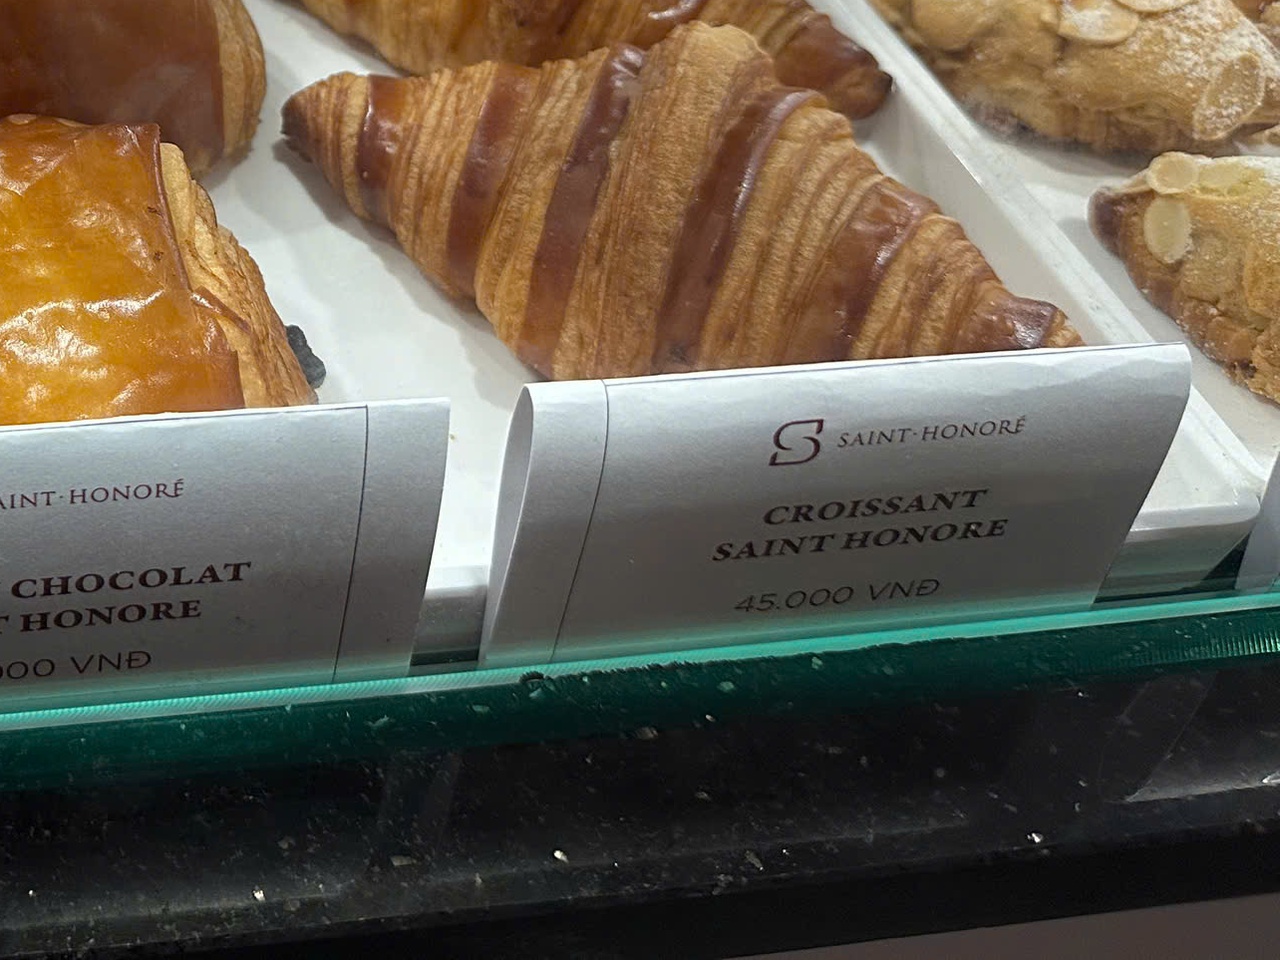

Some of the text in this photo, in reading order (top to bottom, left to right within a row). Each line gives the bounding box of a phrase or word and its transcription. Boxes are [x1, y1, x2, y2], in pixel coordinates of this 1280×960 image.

[762, 489, 990, 526] CROISSANT
[711, 518, 1009, 562] SAINT HONORE
[10, 560, 253, 601] CHOCOLAT
[733, 577, 942, 613] 45.000 VNĐ
[19, 599, 203, 633] HONORE
[69, 649, 153, 675] VNĐ
